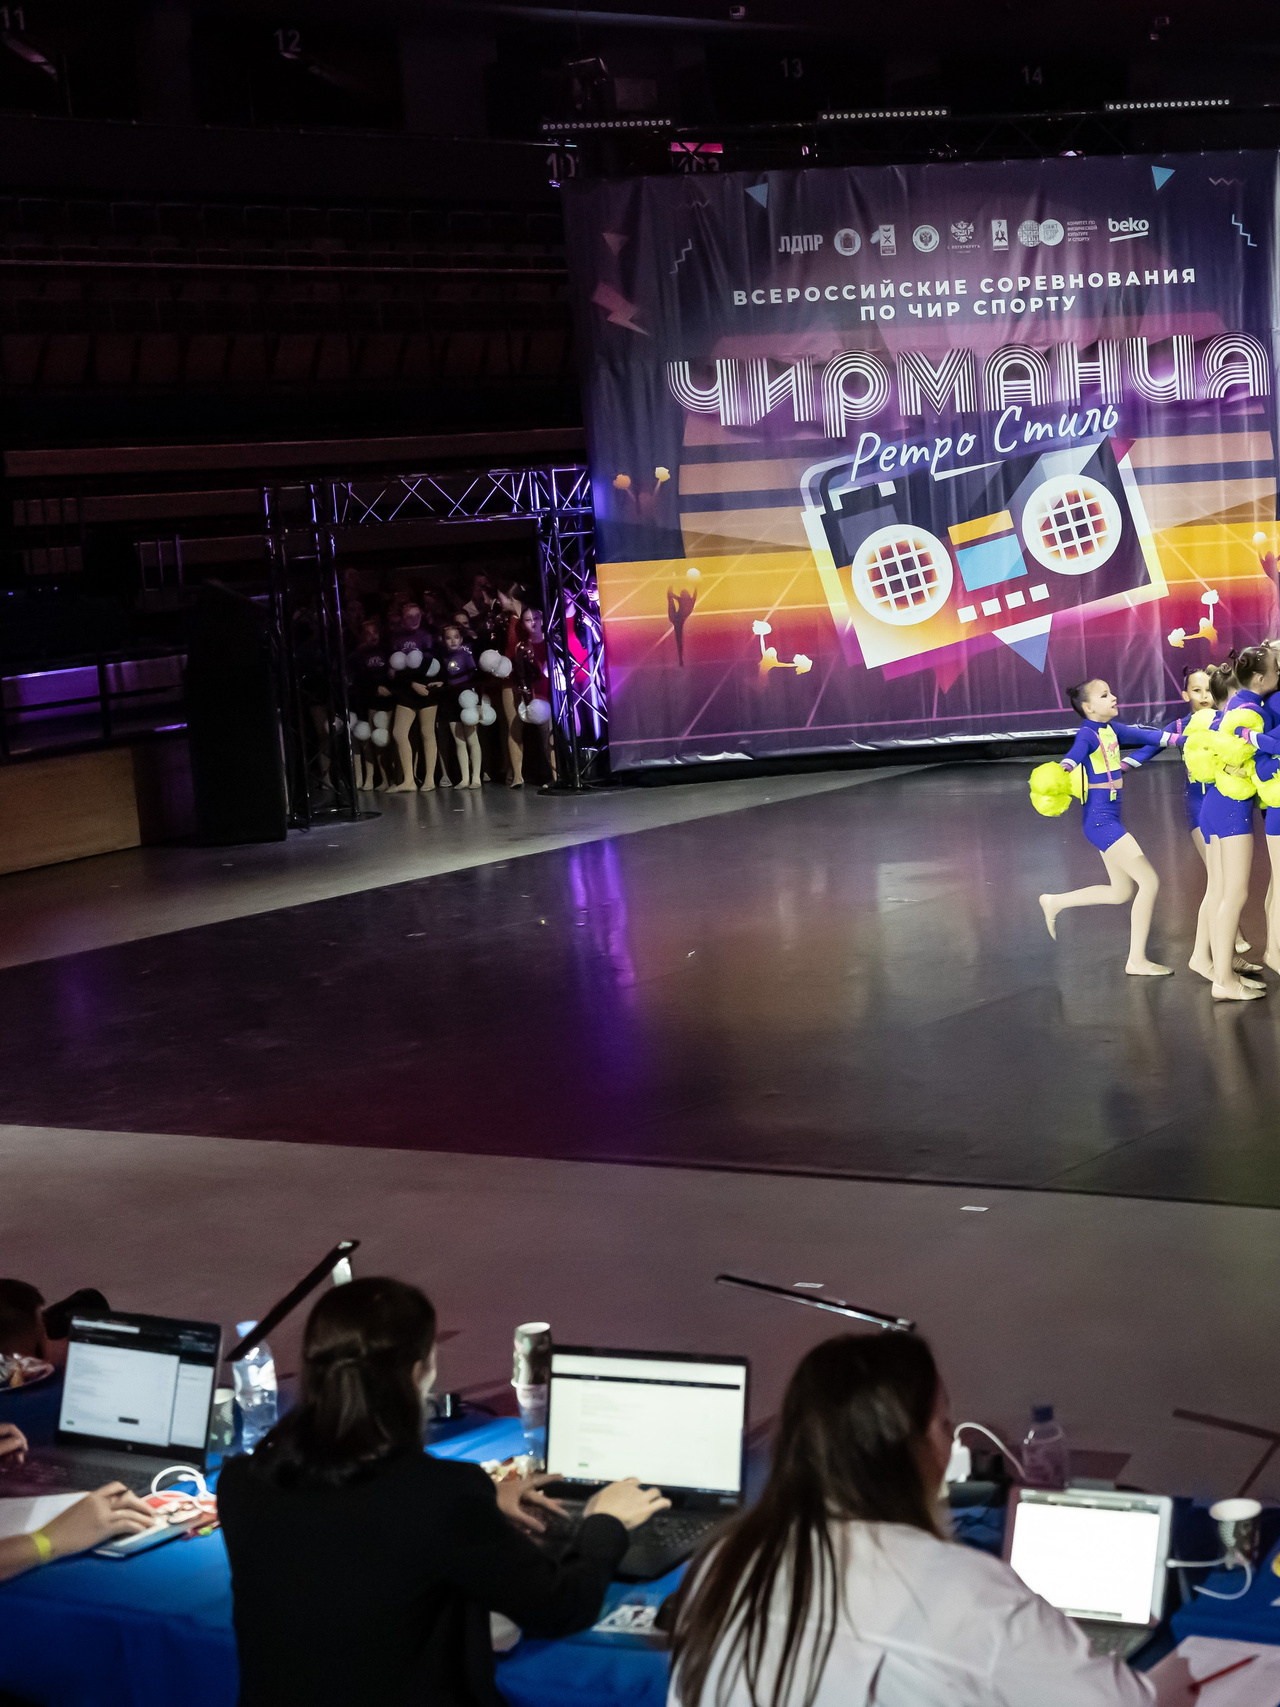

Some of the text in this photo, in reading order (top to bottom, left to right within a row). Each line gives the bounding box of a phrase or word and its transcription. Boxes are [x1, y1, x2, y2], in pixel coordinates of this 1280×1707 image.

[0, 5, 25, 31] 11
[273, 28, 302, 52] 12
[780, 57, 804, 78] 13
[1020, 64, 1044, 85] 14
[1107, 217, 1149, 233] beko
[778, 234, 824, 255] ЛДПР
[733, 268, 1196, 306] ВСЕРОССИЙСКИЕ СОРЕВНОВАНИЯ
[860, 295, 1076, 321] ПО ЧИР СПОРТУ
[851, 404, 1119, 482] Ретро Стиль
